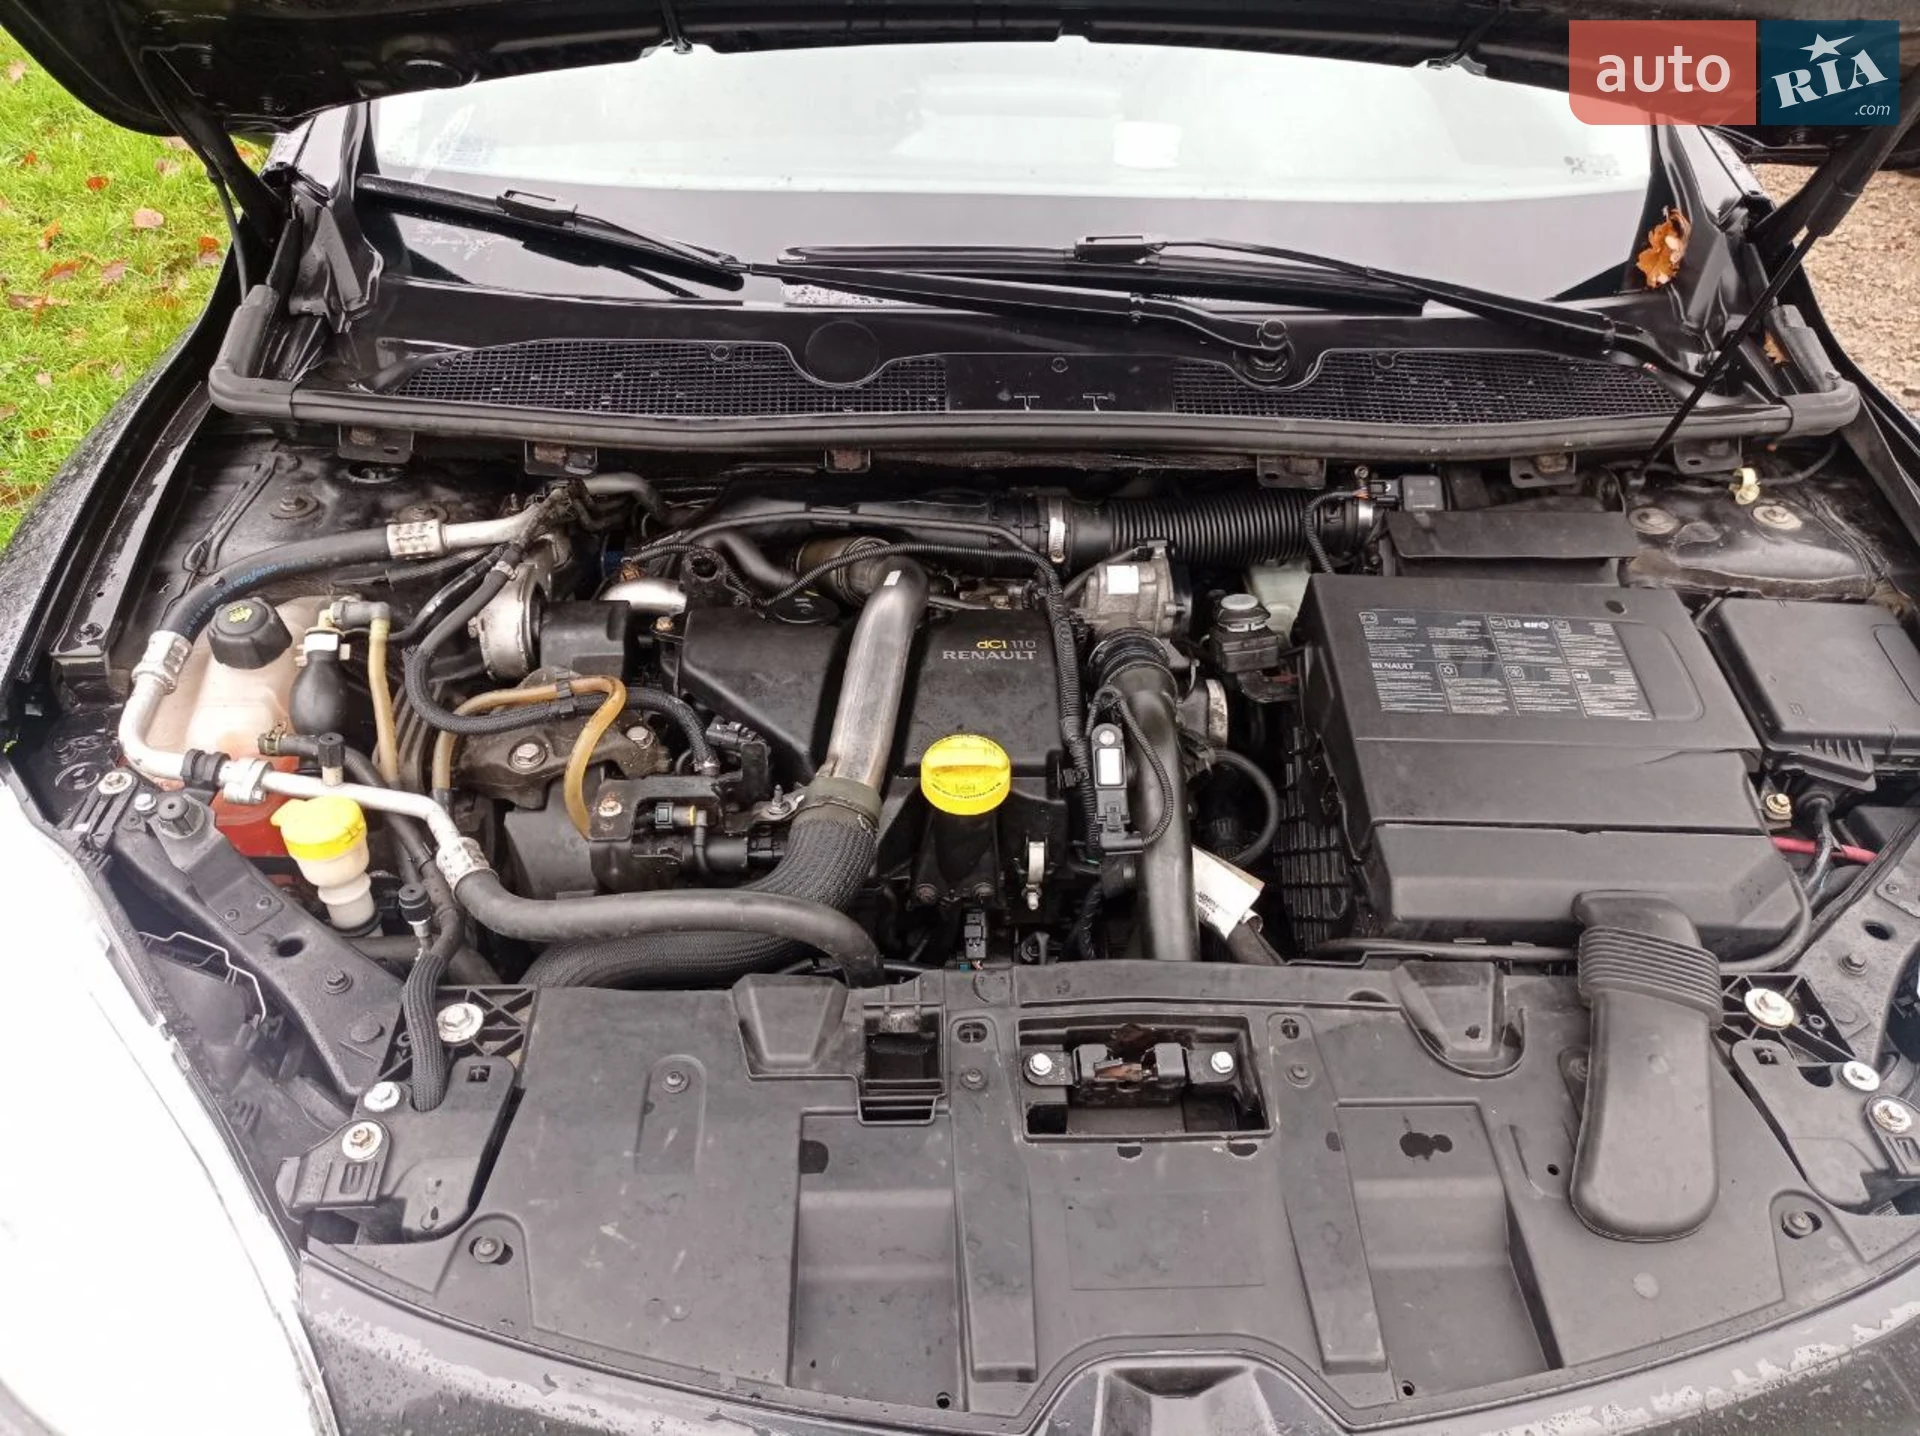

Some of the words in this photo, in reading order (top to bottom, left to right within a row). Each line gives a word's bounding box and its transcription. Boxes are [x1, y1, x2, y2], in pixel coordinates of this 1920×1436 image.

[1011, 640, 1037, 649] 110
[942, 650, 1038, 660] RENAULT
[1371, 662, 1415, 670] RENAULT
